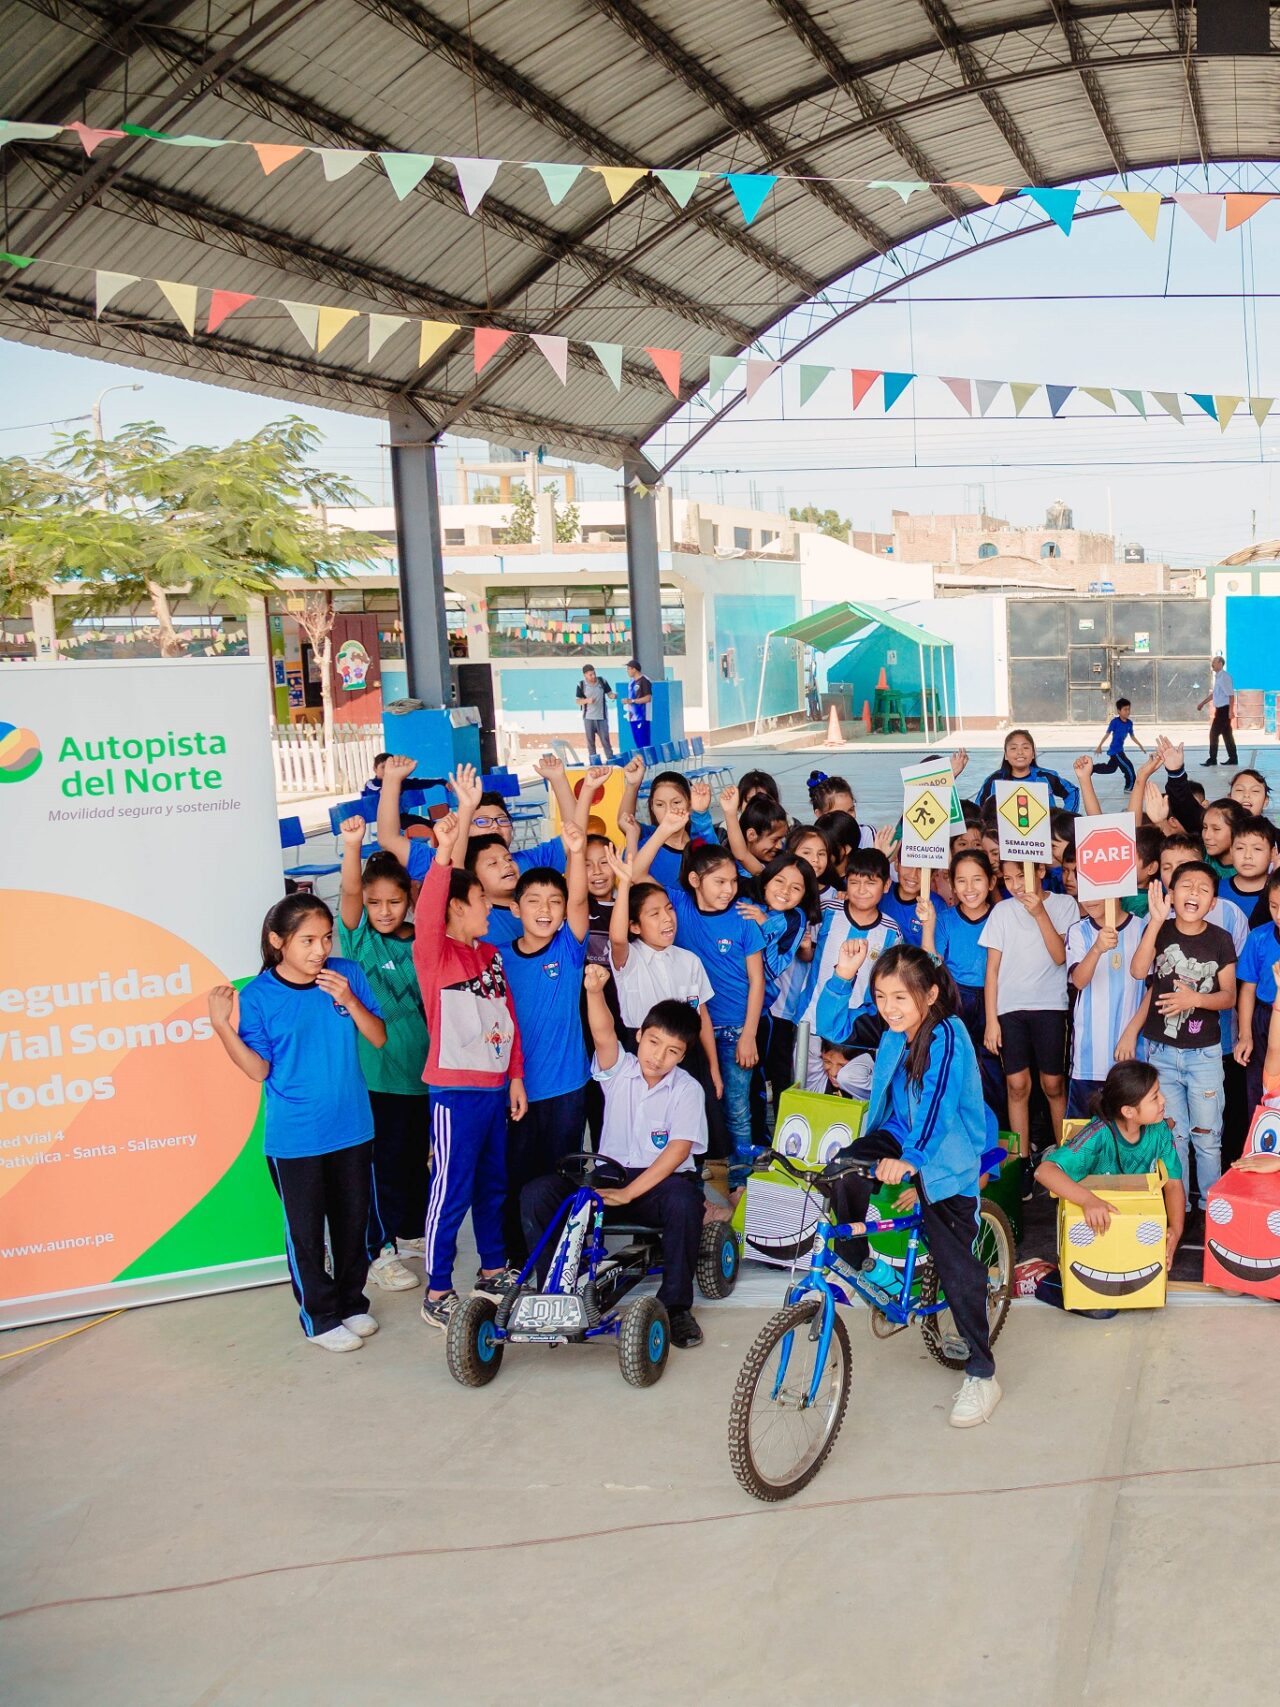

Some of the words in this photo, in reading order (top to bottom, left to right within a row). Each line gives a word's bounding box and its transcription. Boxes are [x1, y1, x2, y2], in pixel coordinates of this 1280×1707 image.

[58, 732, 227, 764] Autopista
[61, 769, 115, 797] del
[124, 767, 222, 794] Norte
[48, 806, 115, 821] Movilidad
[118, 805, 163, 818] segura
[164, 804, 174, 816] y
[176, 799, 241, 813] sostenible
[1005, 839, 1046, 848] SEMAFORO
[1007, 848, 1044, 856] ADELANTE
[1082, 845, 1131, 865] PARE
[0, 964, 193, 1017] eguridad
[69, 1016, 214, 1055] Somos
[23, 1131, 52, 1145] Vial
[55, 1130, 65, 1141] 4
[73, 1144, 117, 1159] Santa
[128, 1134, 197, 1152] Salaverry
[1, 1232, 115, 1258] www.aunor.pe
[533, 1300, 564, 1322] 01
